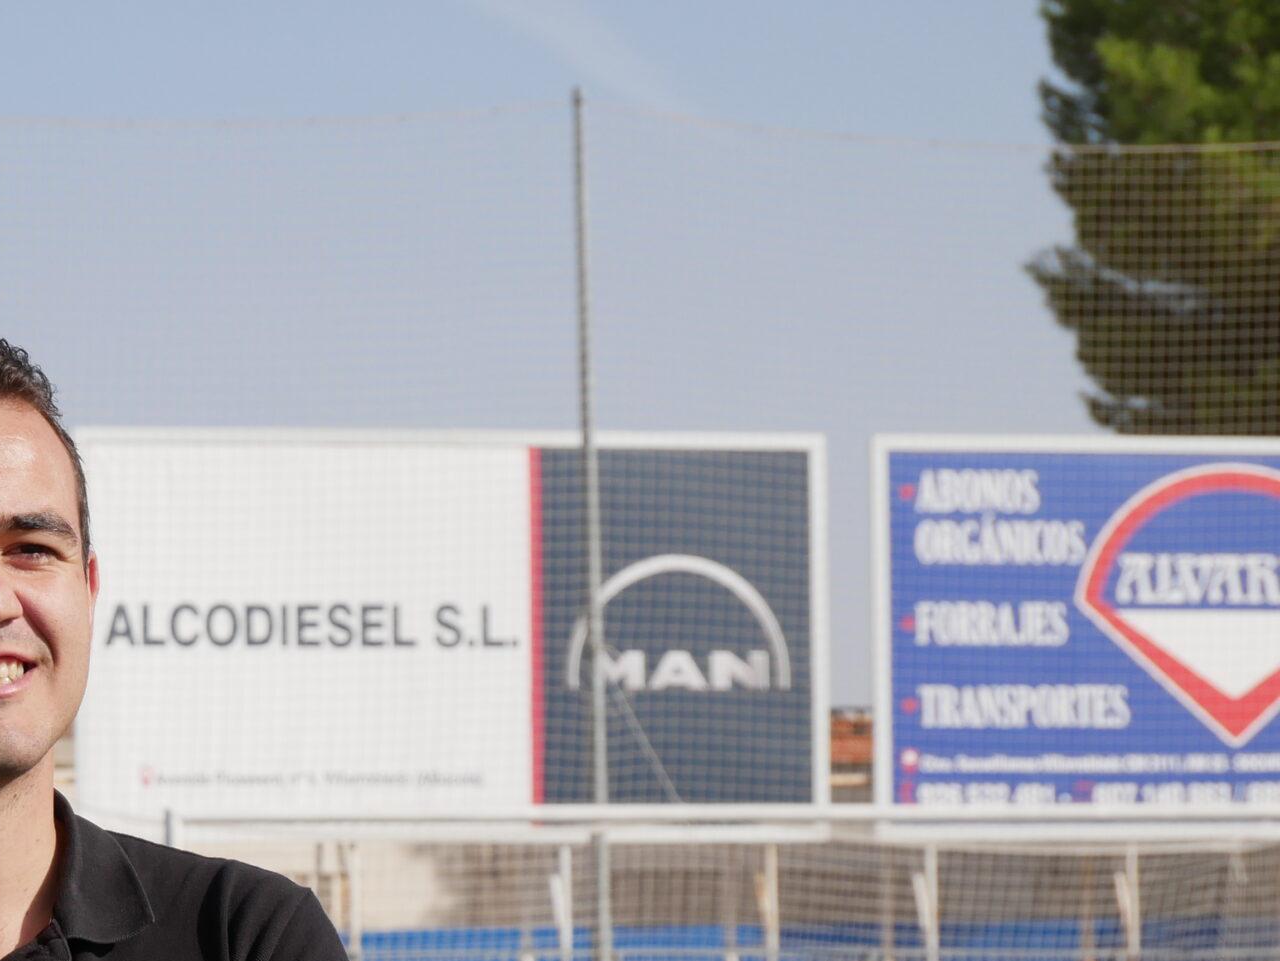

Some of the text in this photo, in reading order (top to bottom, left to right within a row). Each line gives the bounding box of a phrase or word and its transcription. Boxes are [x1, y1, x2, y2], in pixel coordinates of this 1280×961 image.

[914, 468, 1041, 515] ABONOS
[106, 602, 519, 648] ALCODIESEL S.L.
[914, 600, 1070, 647] FORRAJES
[593, 649, 770, 691] MAN
[916, 684, 1131, 730] TRANSPORTES
